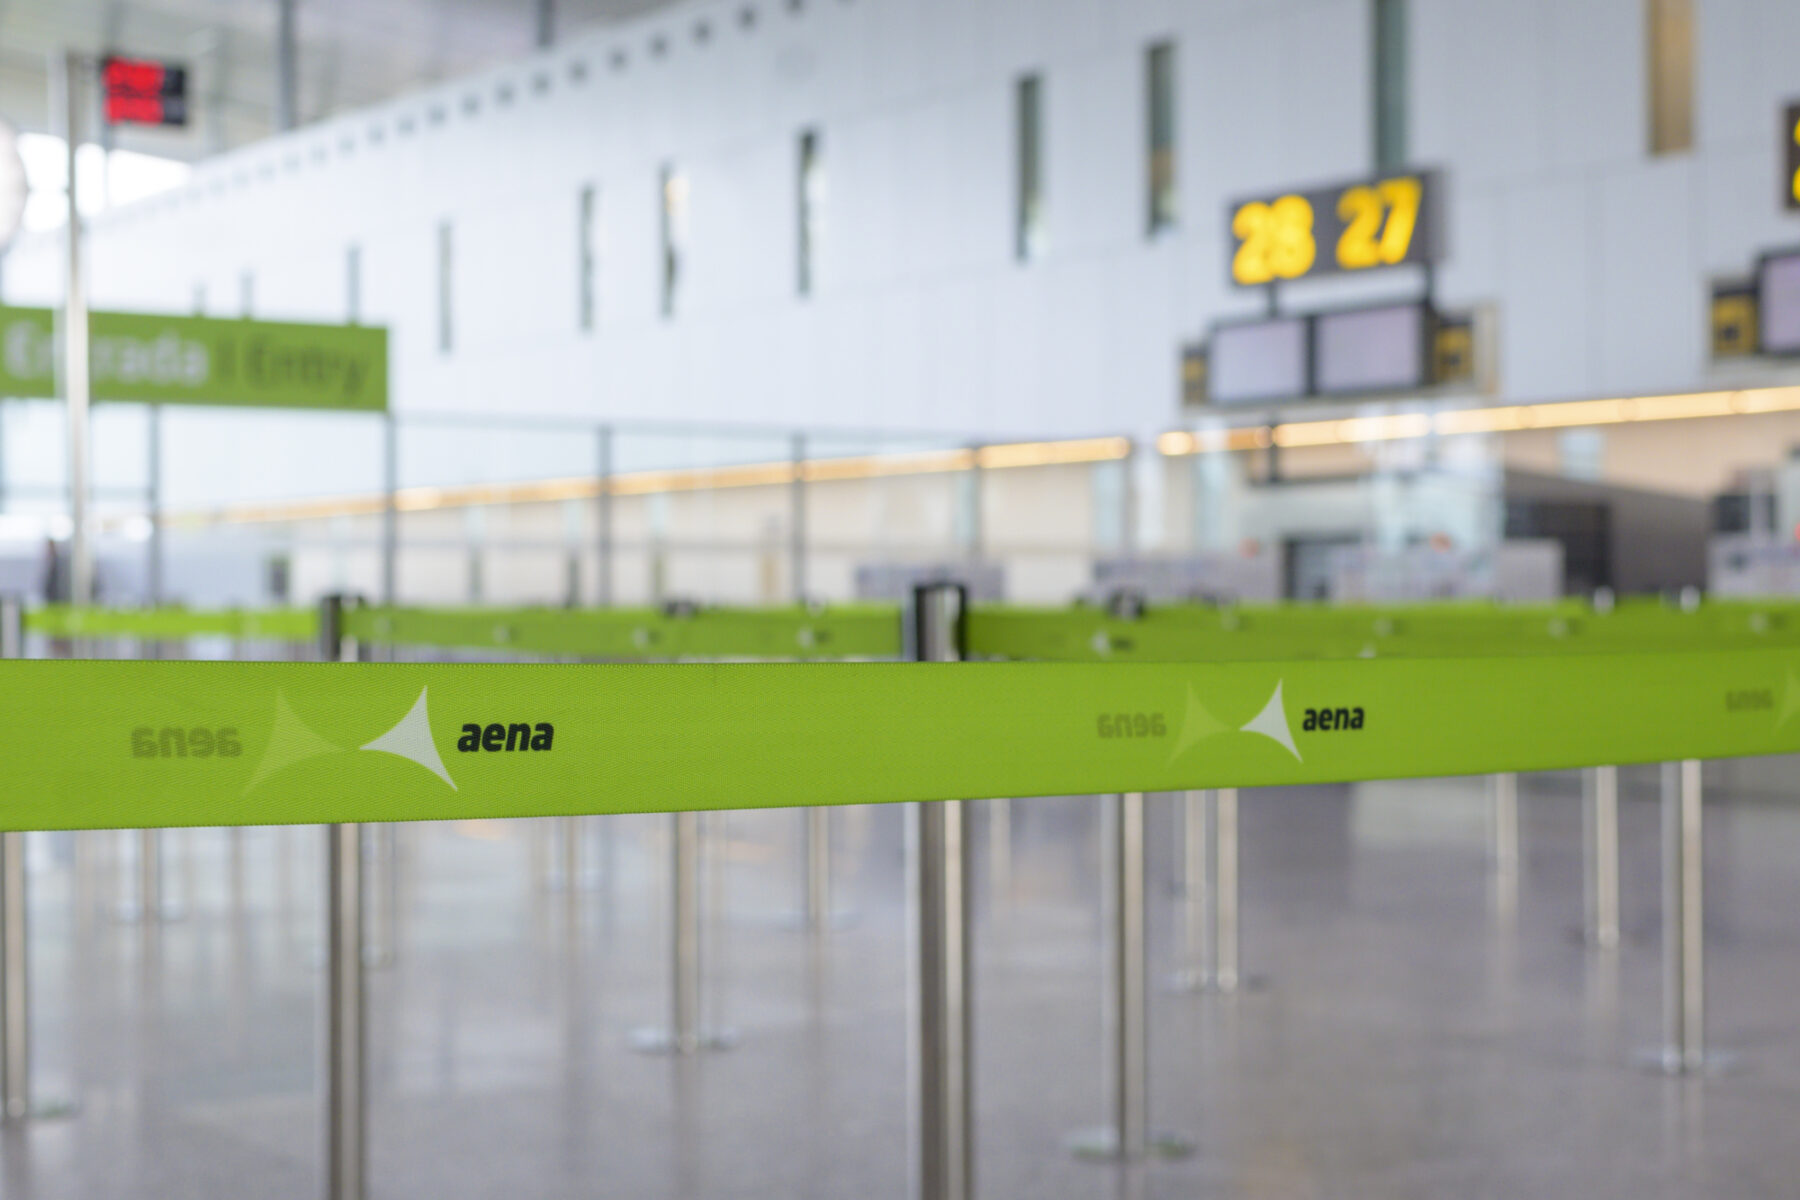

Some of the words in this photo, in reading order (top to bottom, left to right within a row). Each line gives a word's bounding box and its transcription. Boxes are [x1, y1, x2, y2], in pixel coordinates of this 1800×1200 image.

[1232, 194, 1316, 285] 28
[1336, 176, 1423, 269] 27
[4, 320, 209, 388] Enrada
[457, 722, 554, 752] aena
[1302, 706, 1365, 732] aena
